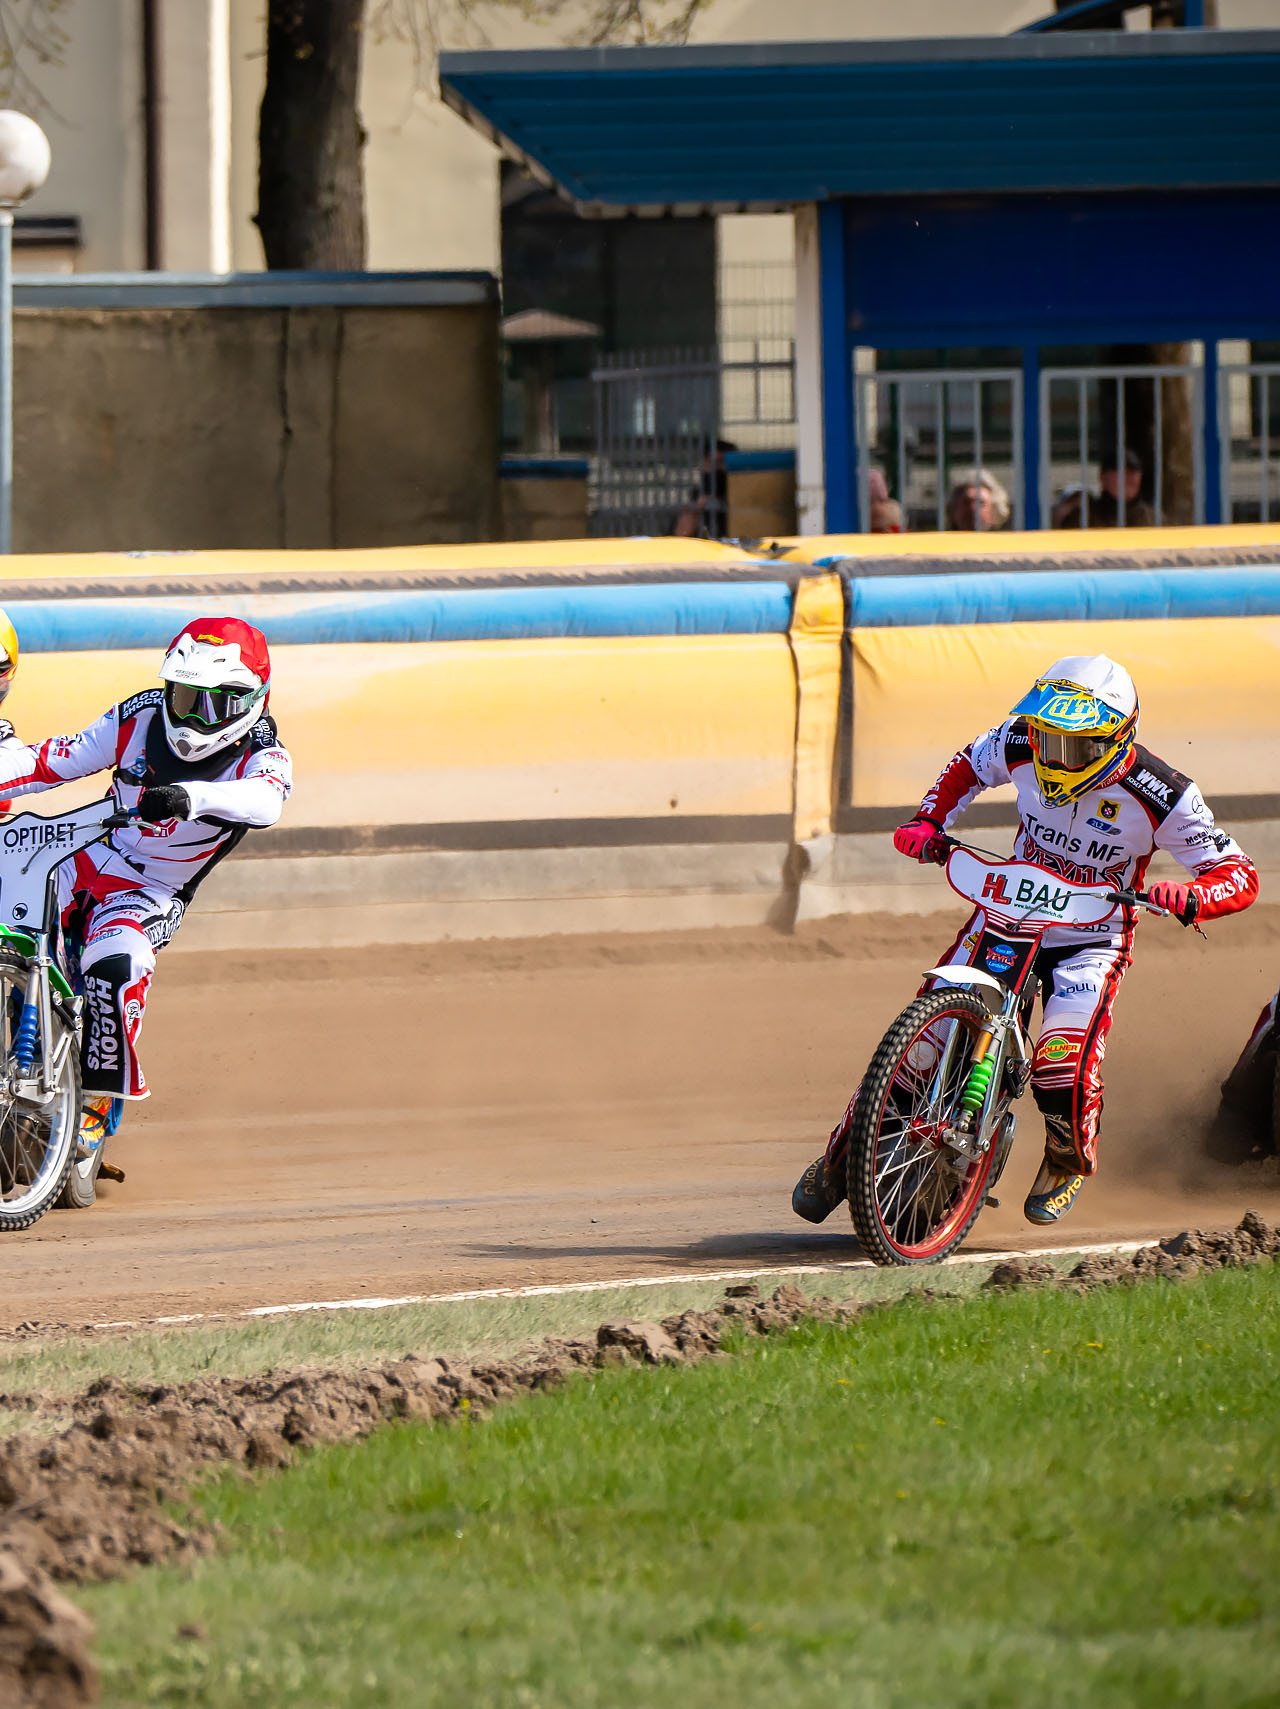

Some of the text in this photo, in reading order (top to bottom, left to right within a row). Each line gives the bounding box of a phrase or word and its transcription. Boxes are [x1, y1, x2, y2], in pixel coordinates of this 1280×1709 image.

[122, 698, 164, 719] SHOCK
[1006, 732, 1032, 745] Tran
[1136, 768, 1174, 802] WWK
[3, 822, 77, 848] OPTIBET
[1026, 813, 1125, 862] Trans MF
[1016, 878, 1072, 912] BAU
[985, 946, 1018, 967] DEVILS
[84, 975, 100, 1071] SHOCKS
[96, 977, 119, 1071] HAGON
